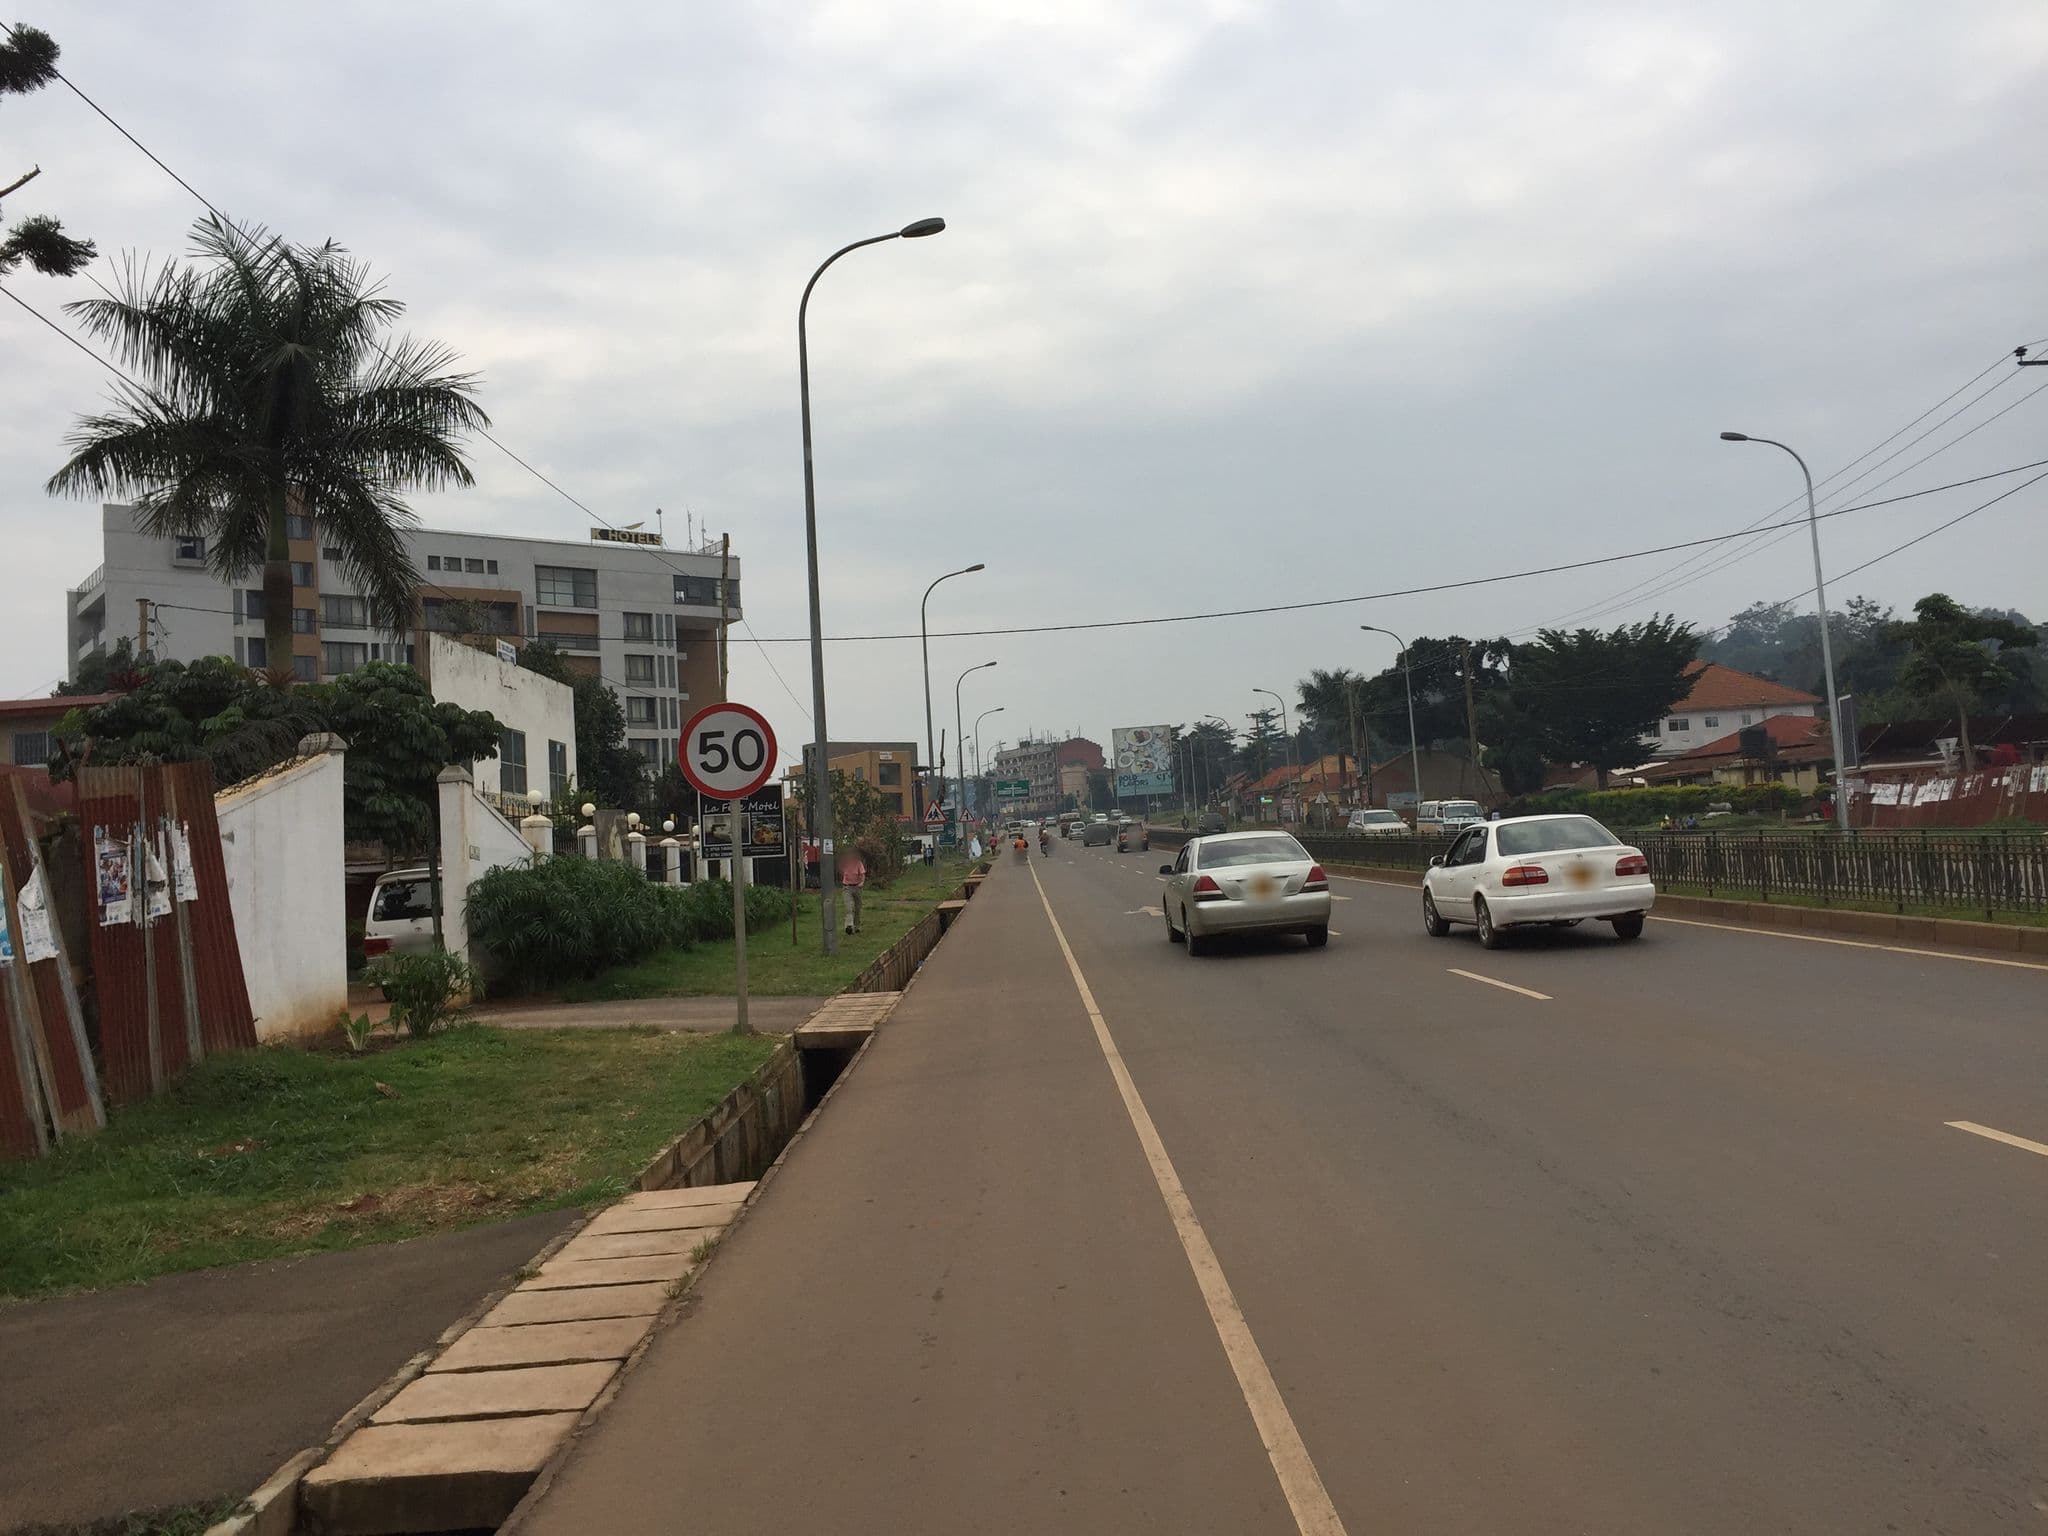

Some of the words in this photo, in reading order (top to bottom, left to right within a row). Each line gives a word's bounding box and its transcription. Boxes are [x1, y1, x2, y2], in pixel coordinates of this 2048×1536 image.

[608, 531, 662, 544] HOTELS
[699, 729, 764, 773] 50
[704, 805, 719, 813] La
[748, 801, 779, 811] Motel
